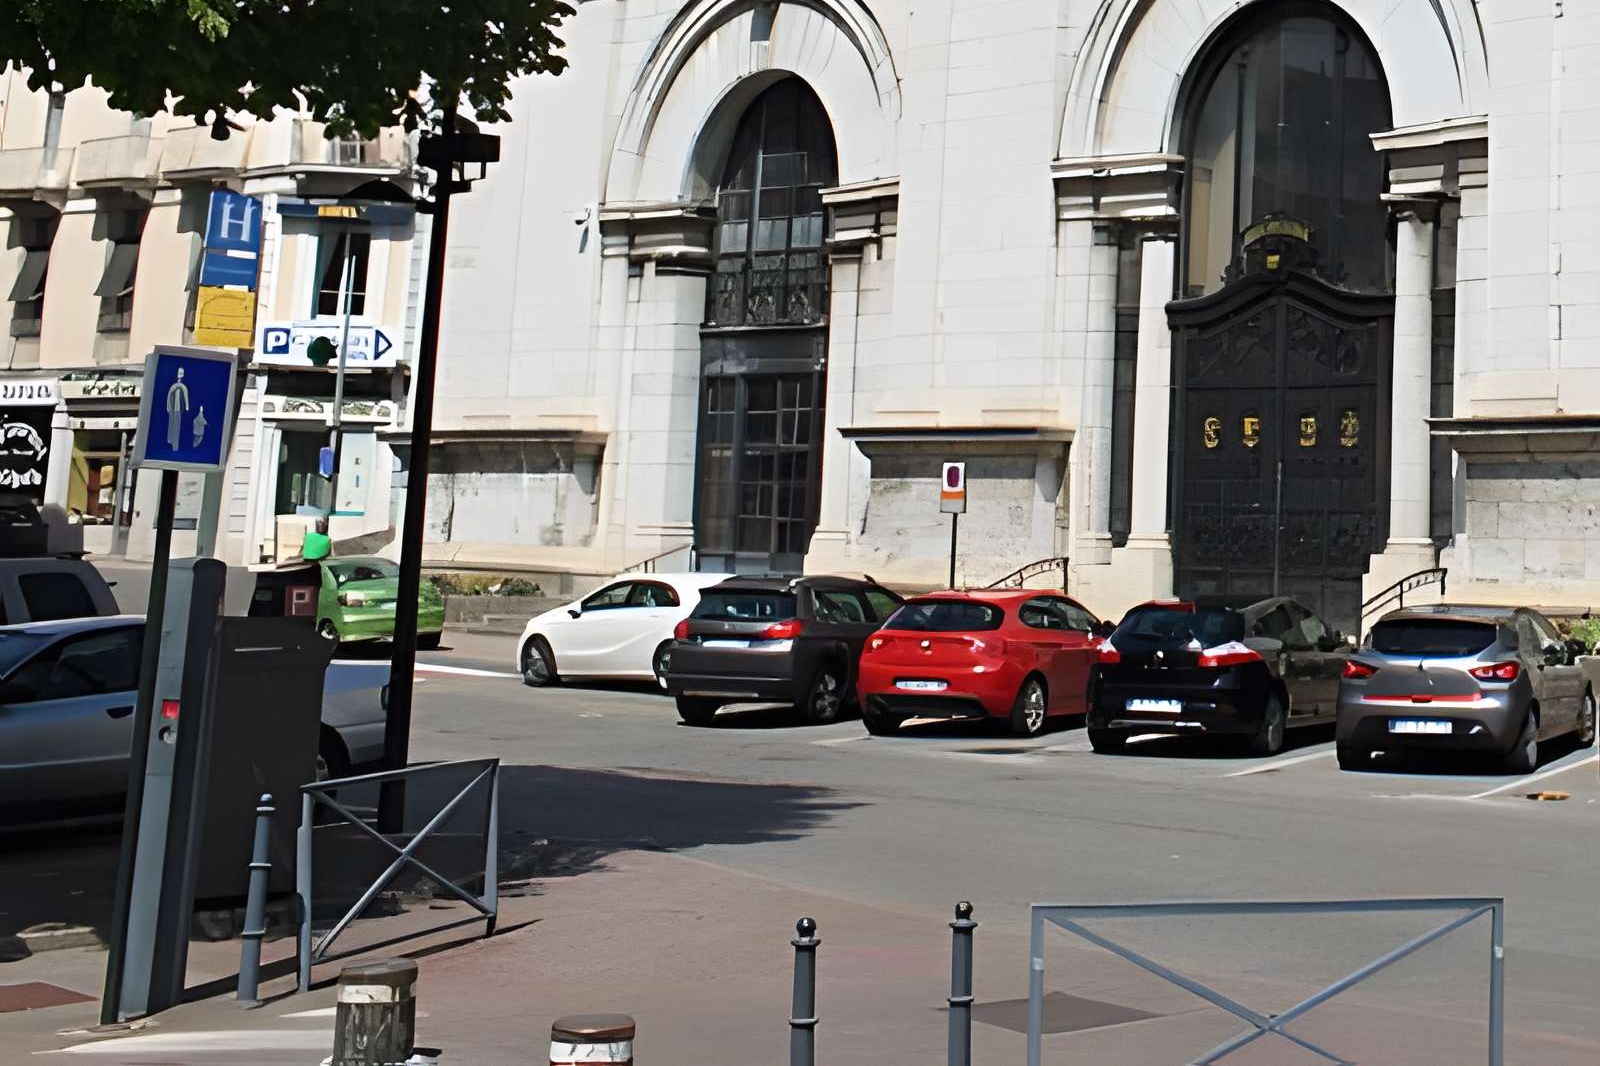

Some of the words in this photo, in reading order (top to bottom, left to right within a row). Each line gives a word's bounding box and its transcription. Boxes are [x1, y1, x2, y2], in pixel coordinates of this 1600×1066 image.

[220, 194, 257, 243] H
[266, 330, 288, 353] P
[292, 589, 311, 615] P
